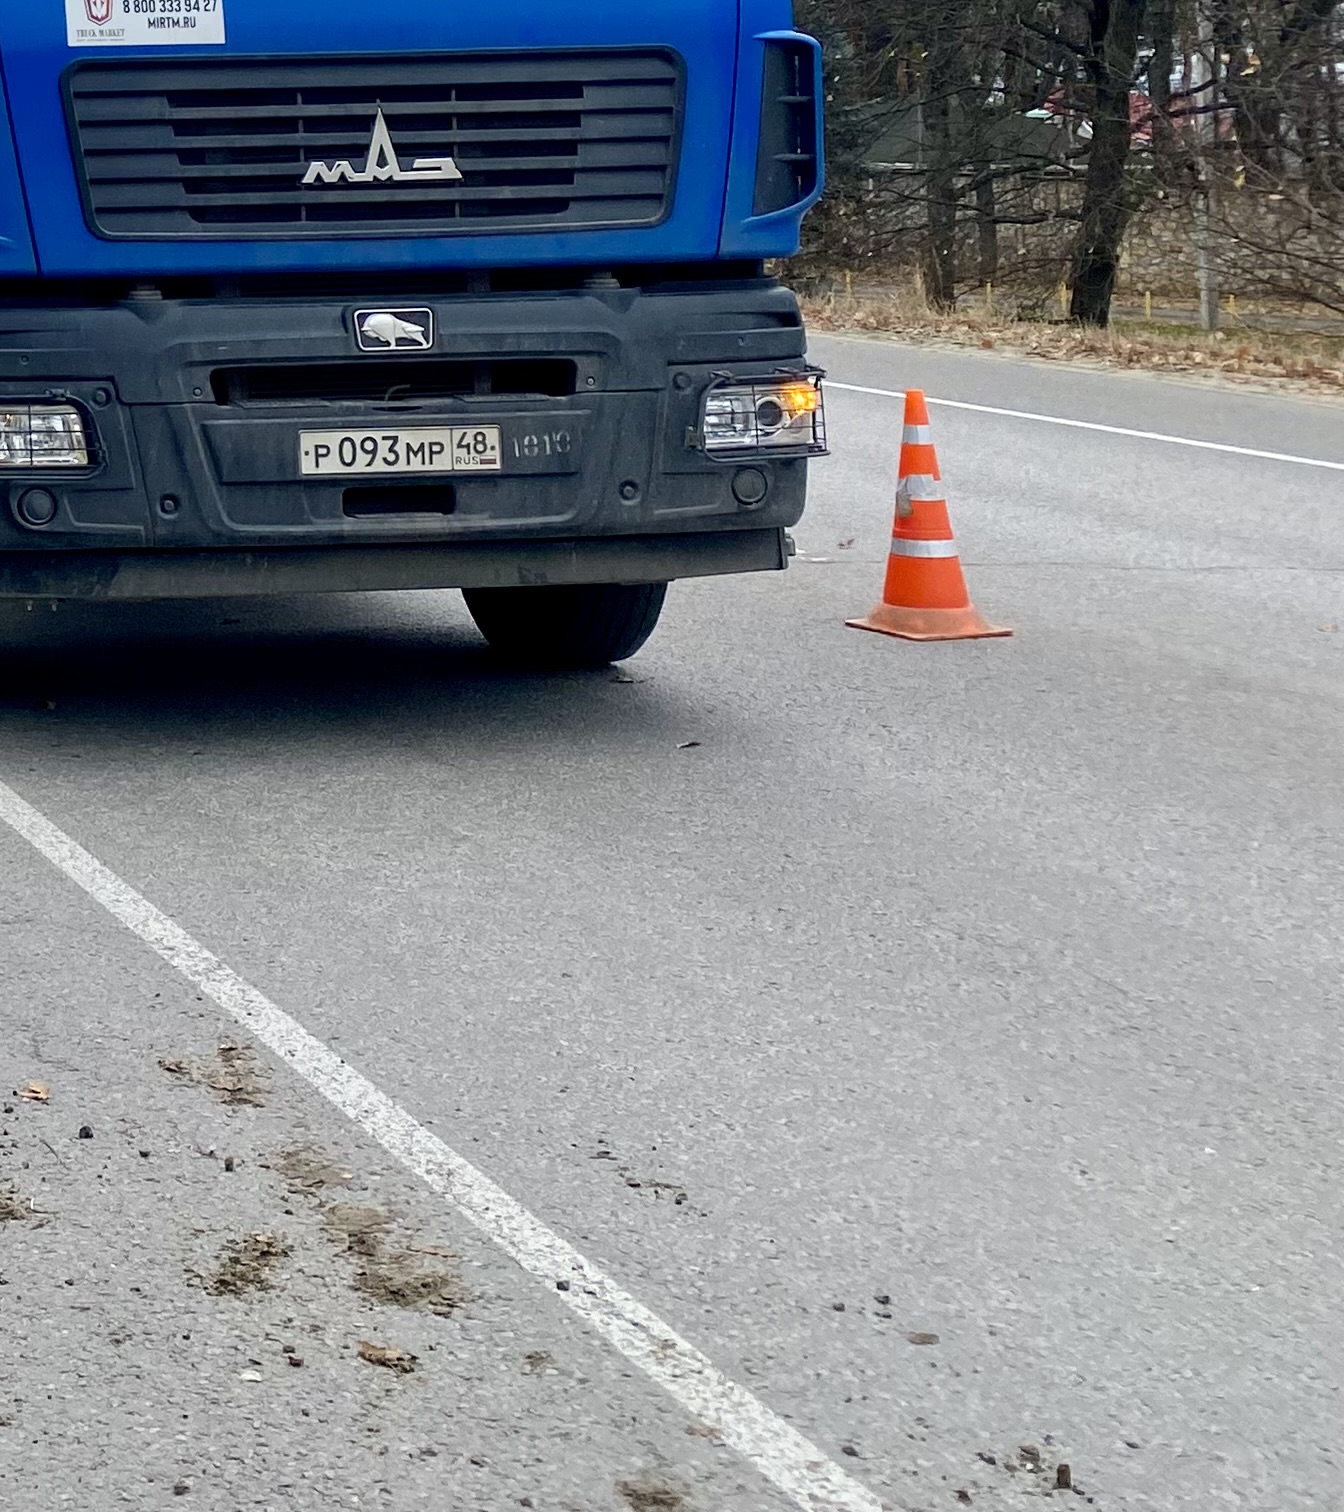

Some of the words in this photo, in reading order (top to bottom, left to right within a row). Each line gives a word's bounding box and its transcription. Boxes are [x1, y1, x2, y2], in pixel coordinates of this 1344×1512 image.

[122, 0, 131, 14] 8
[133, 0, 156, 14] 800
[147, 16, 197, 29] MIRTM.RU
[456, 431, 488, 455] 48
[455, 456, 479, 465] RUS
